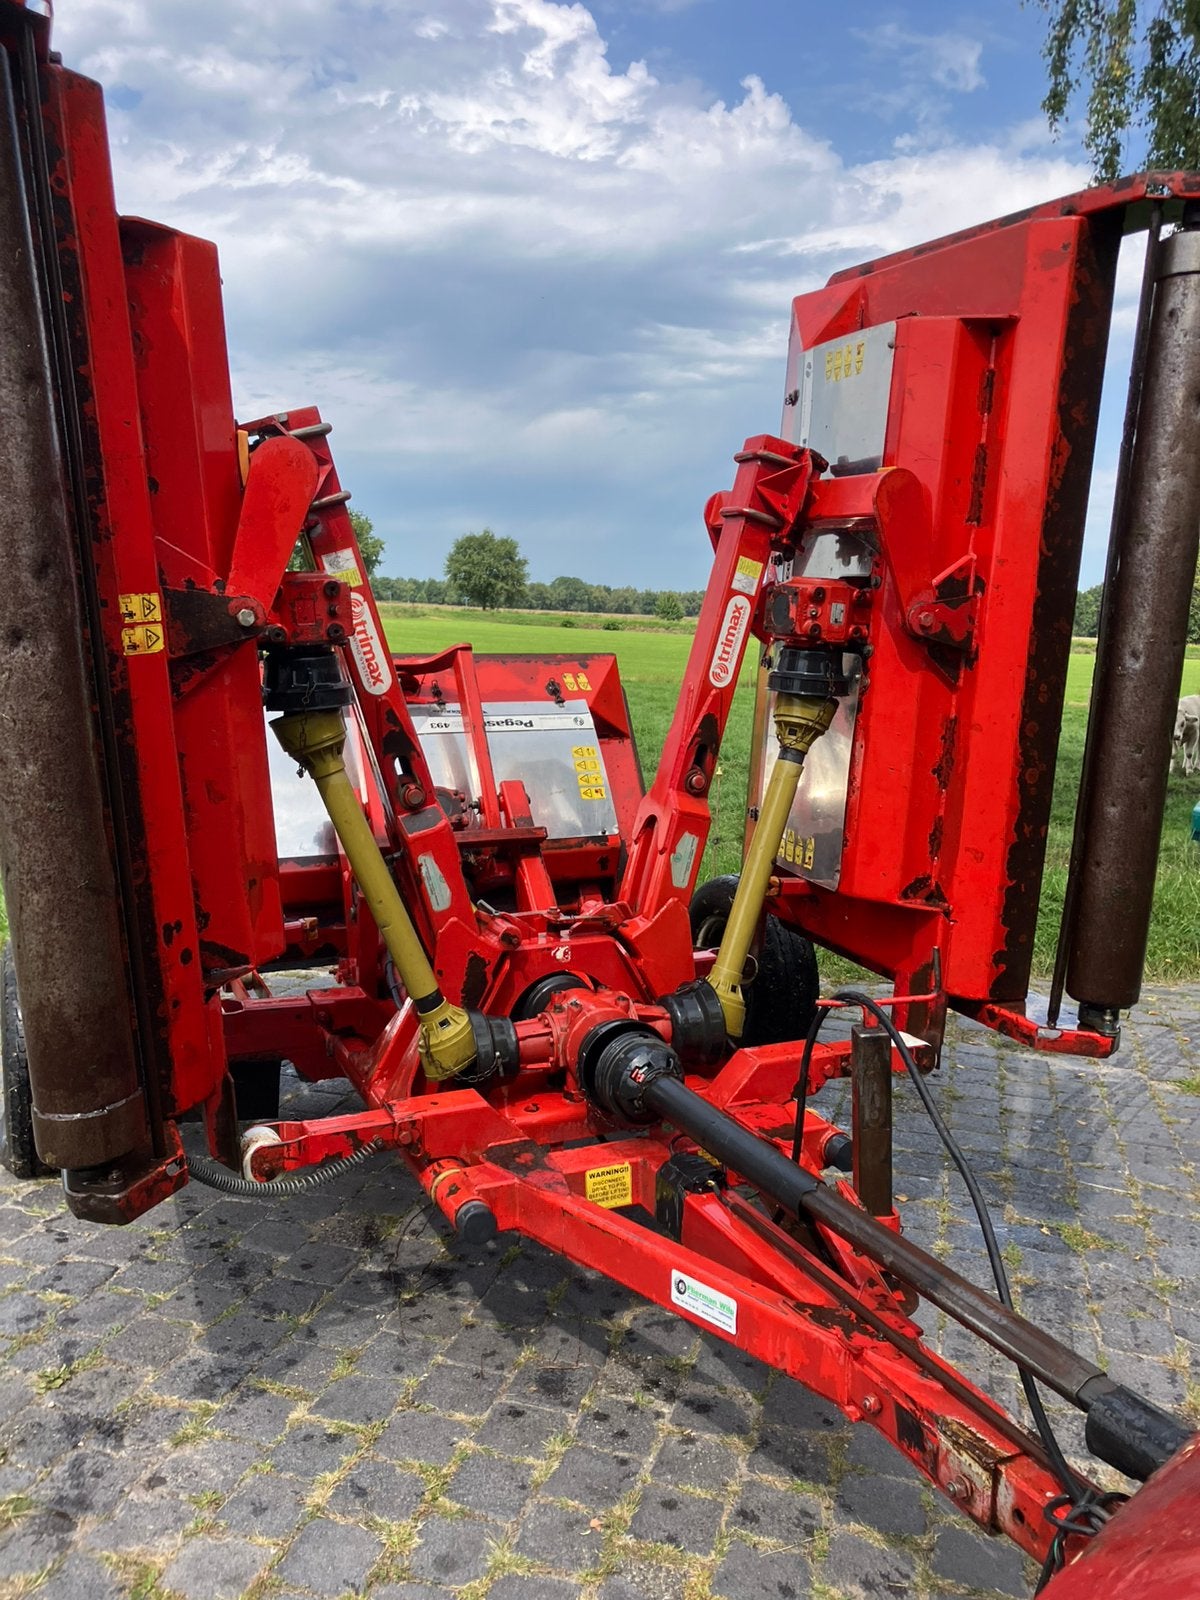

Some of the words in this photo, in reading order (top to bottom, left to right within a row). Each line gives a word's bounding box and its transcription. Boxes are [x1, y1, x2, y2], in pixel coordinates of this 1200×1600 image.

[718, 603, 744, 662] trimax
[353, 619, 384, 687] trimax
[589, 1191, 609, 1199] BEFORE
[593, 1176, 625, 1186] DISCONNECT
